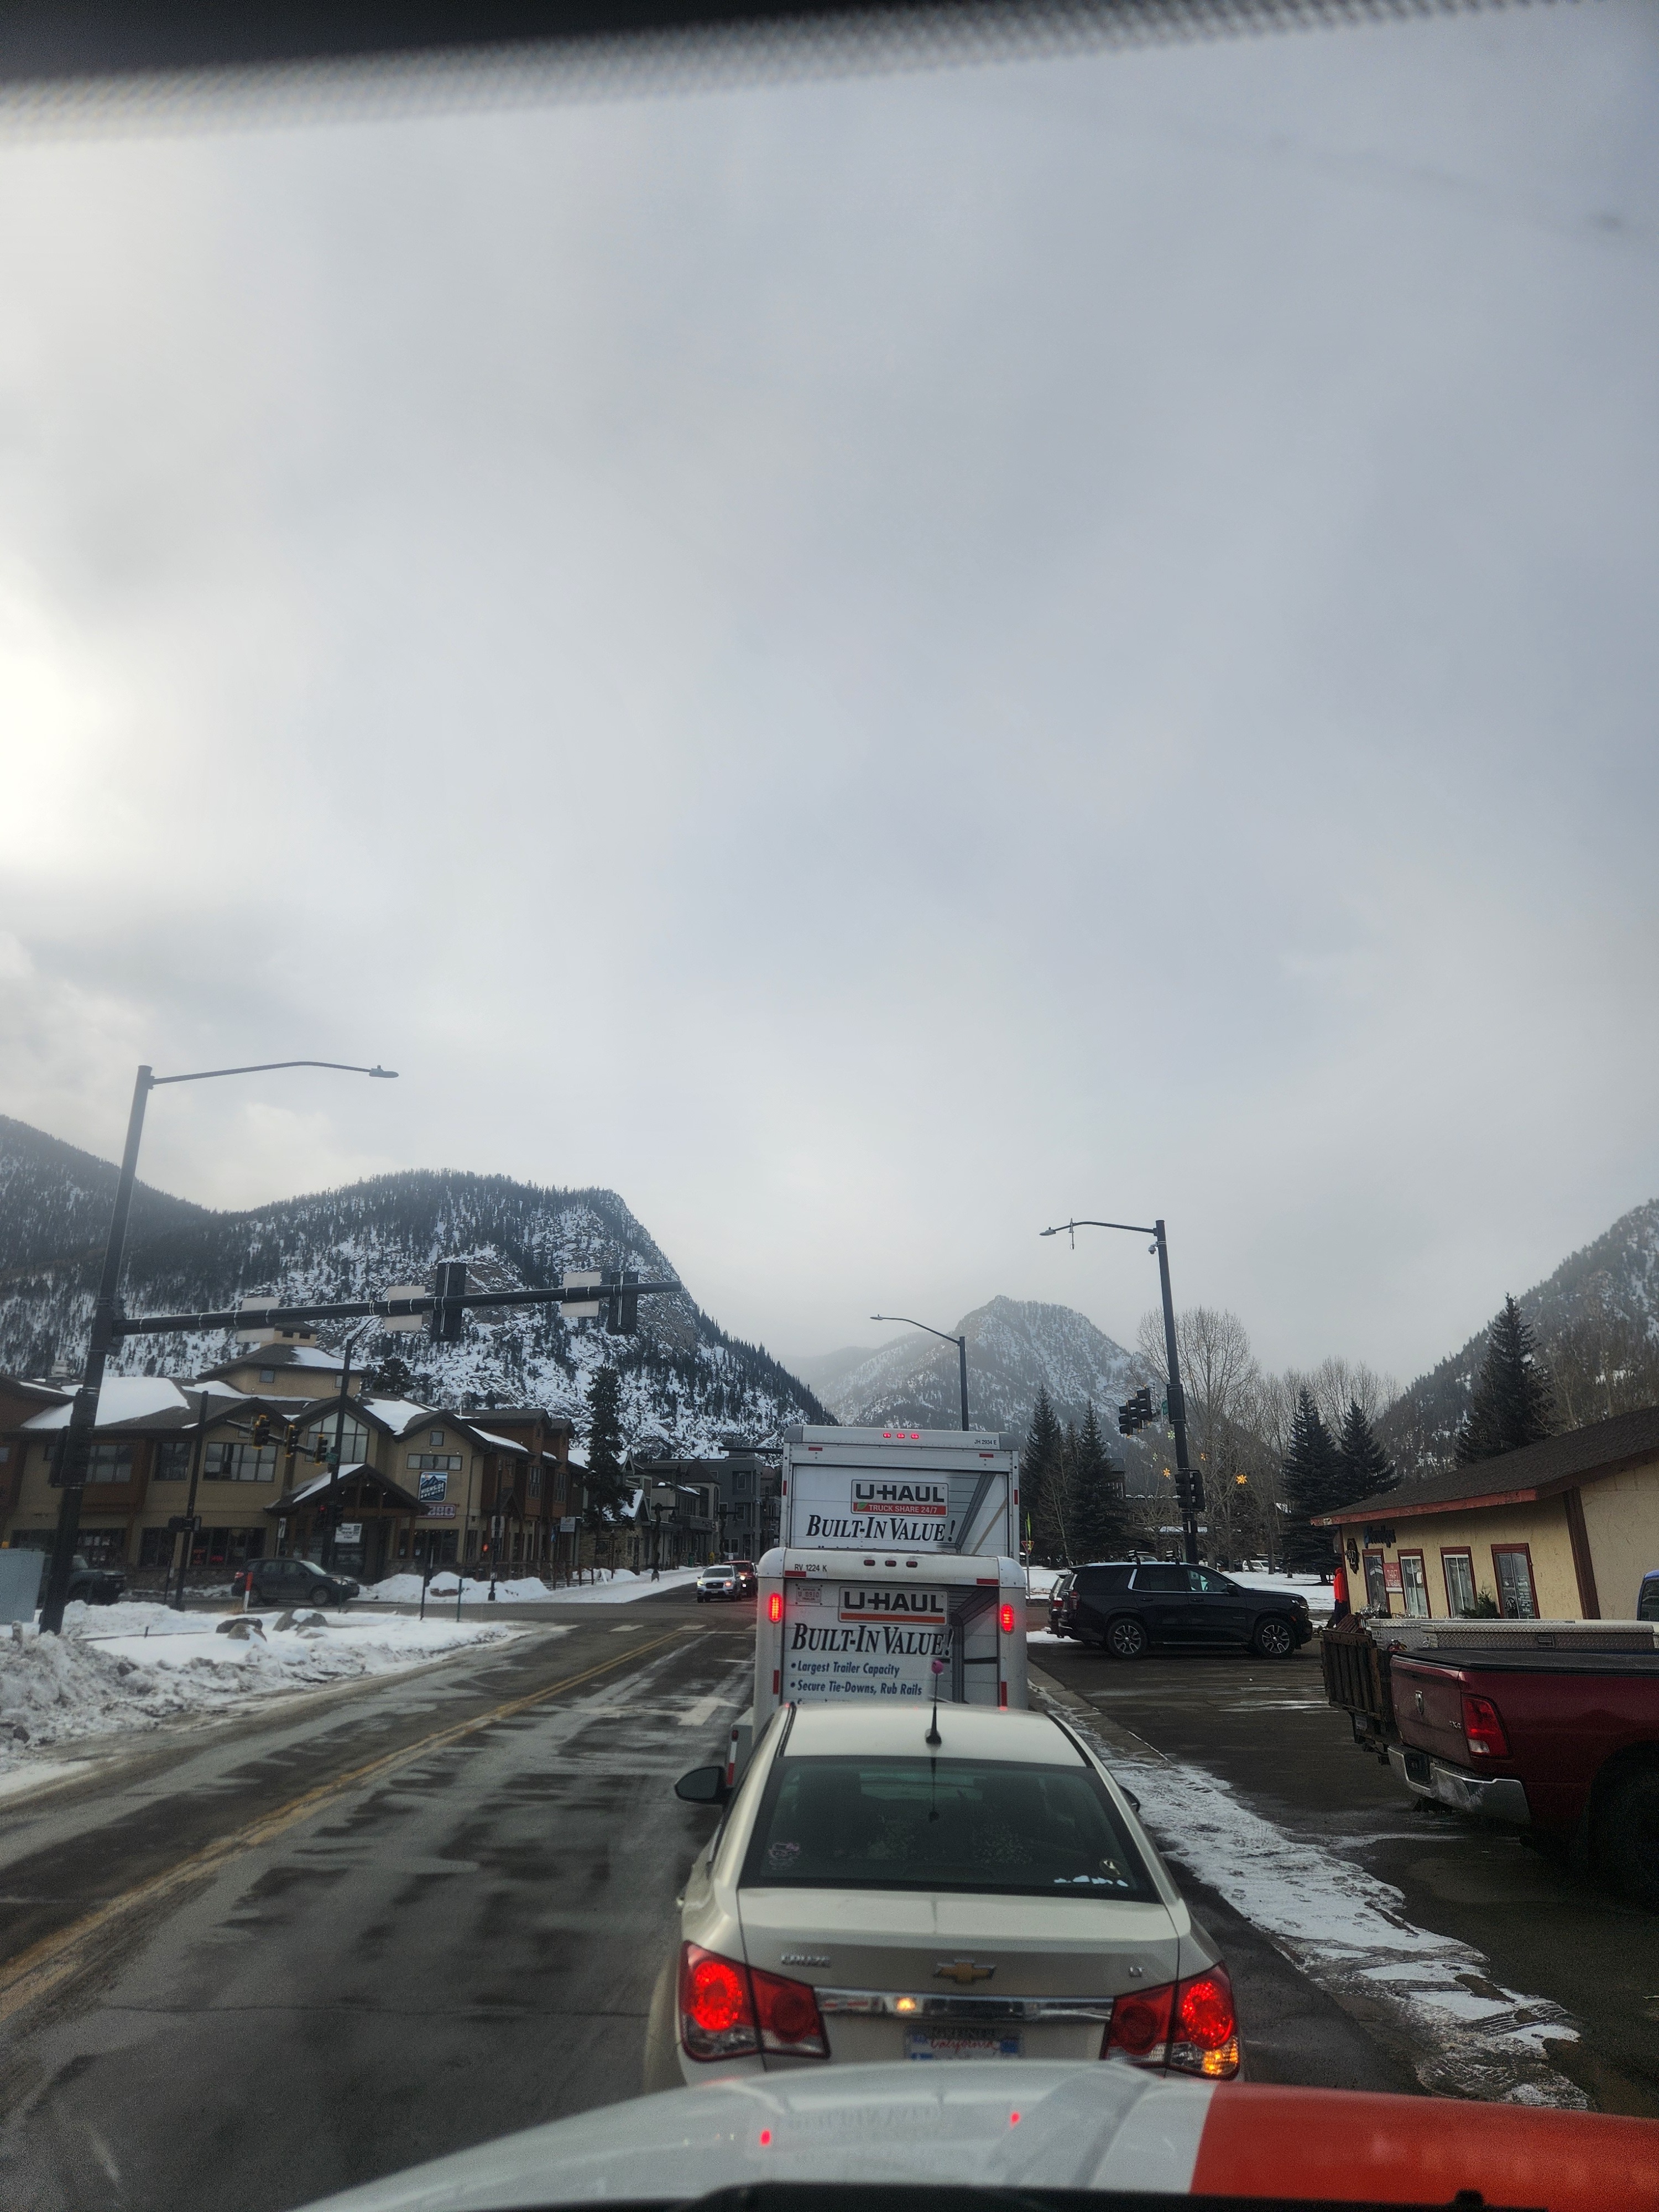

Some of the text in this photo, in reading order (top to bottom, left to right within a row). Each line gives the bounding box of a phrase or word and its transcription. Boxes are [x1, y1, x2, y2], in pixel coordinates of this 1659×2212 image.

[855, 1484, 945, 1503] U-HAUL
[844, 1592, 944, 1613] U-HAUL
[797, 1661, 900, 1678] Largest Trailer Capacity
[797, 1679, 922, 1695] Secure Tie-Downs, Rub Rails
